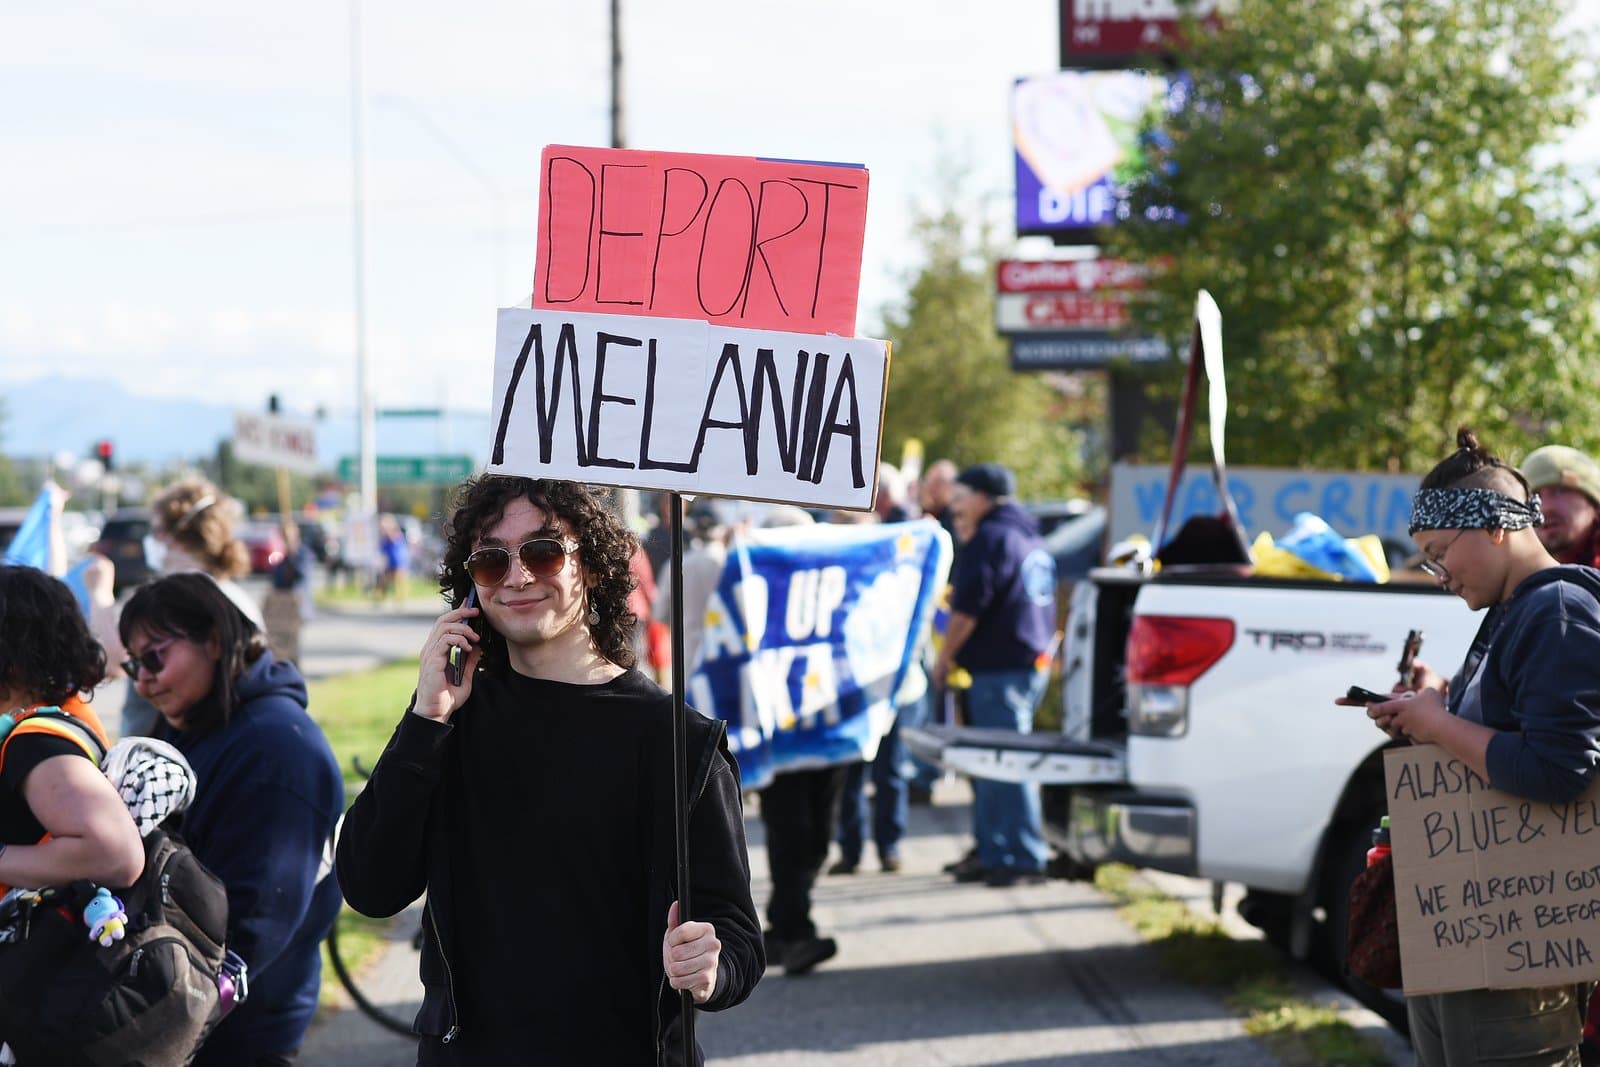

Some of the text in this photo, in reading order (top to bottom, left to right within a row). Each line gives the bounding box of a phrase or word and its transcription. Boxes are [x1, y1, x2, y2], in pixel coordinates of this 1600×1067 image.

[545, 156, 859, 319] DEPORT
[491, 323, 866, 489] MELANIA
[1134, 475, 1257, 529] WAR
[785, 565, 847, 641] UP
[1394, 759, 1491, 801] ALASK
[1423, 806, 1512, 859] BLUE
[1517, 802, 1546, 844] &
[1415, 883, 1449, 917] WE
[1462, 870, 1555, 909] ALREADY
[1434, 910, 1522, 948] RUSSIA
[1505, 937, 1594, 973] SLAVA
